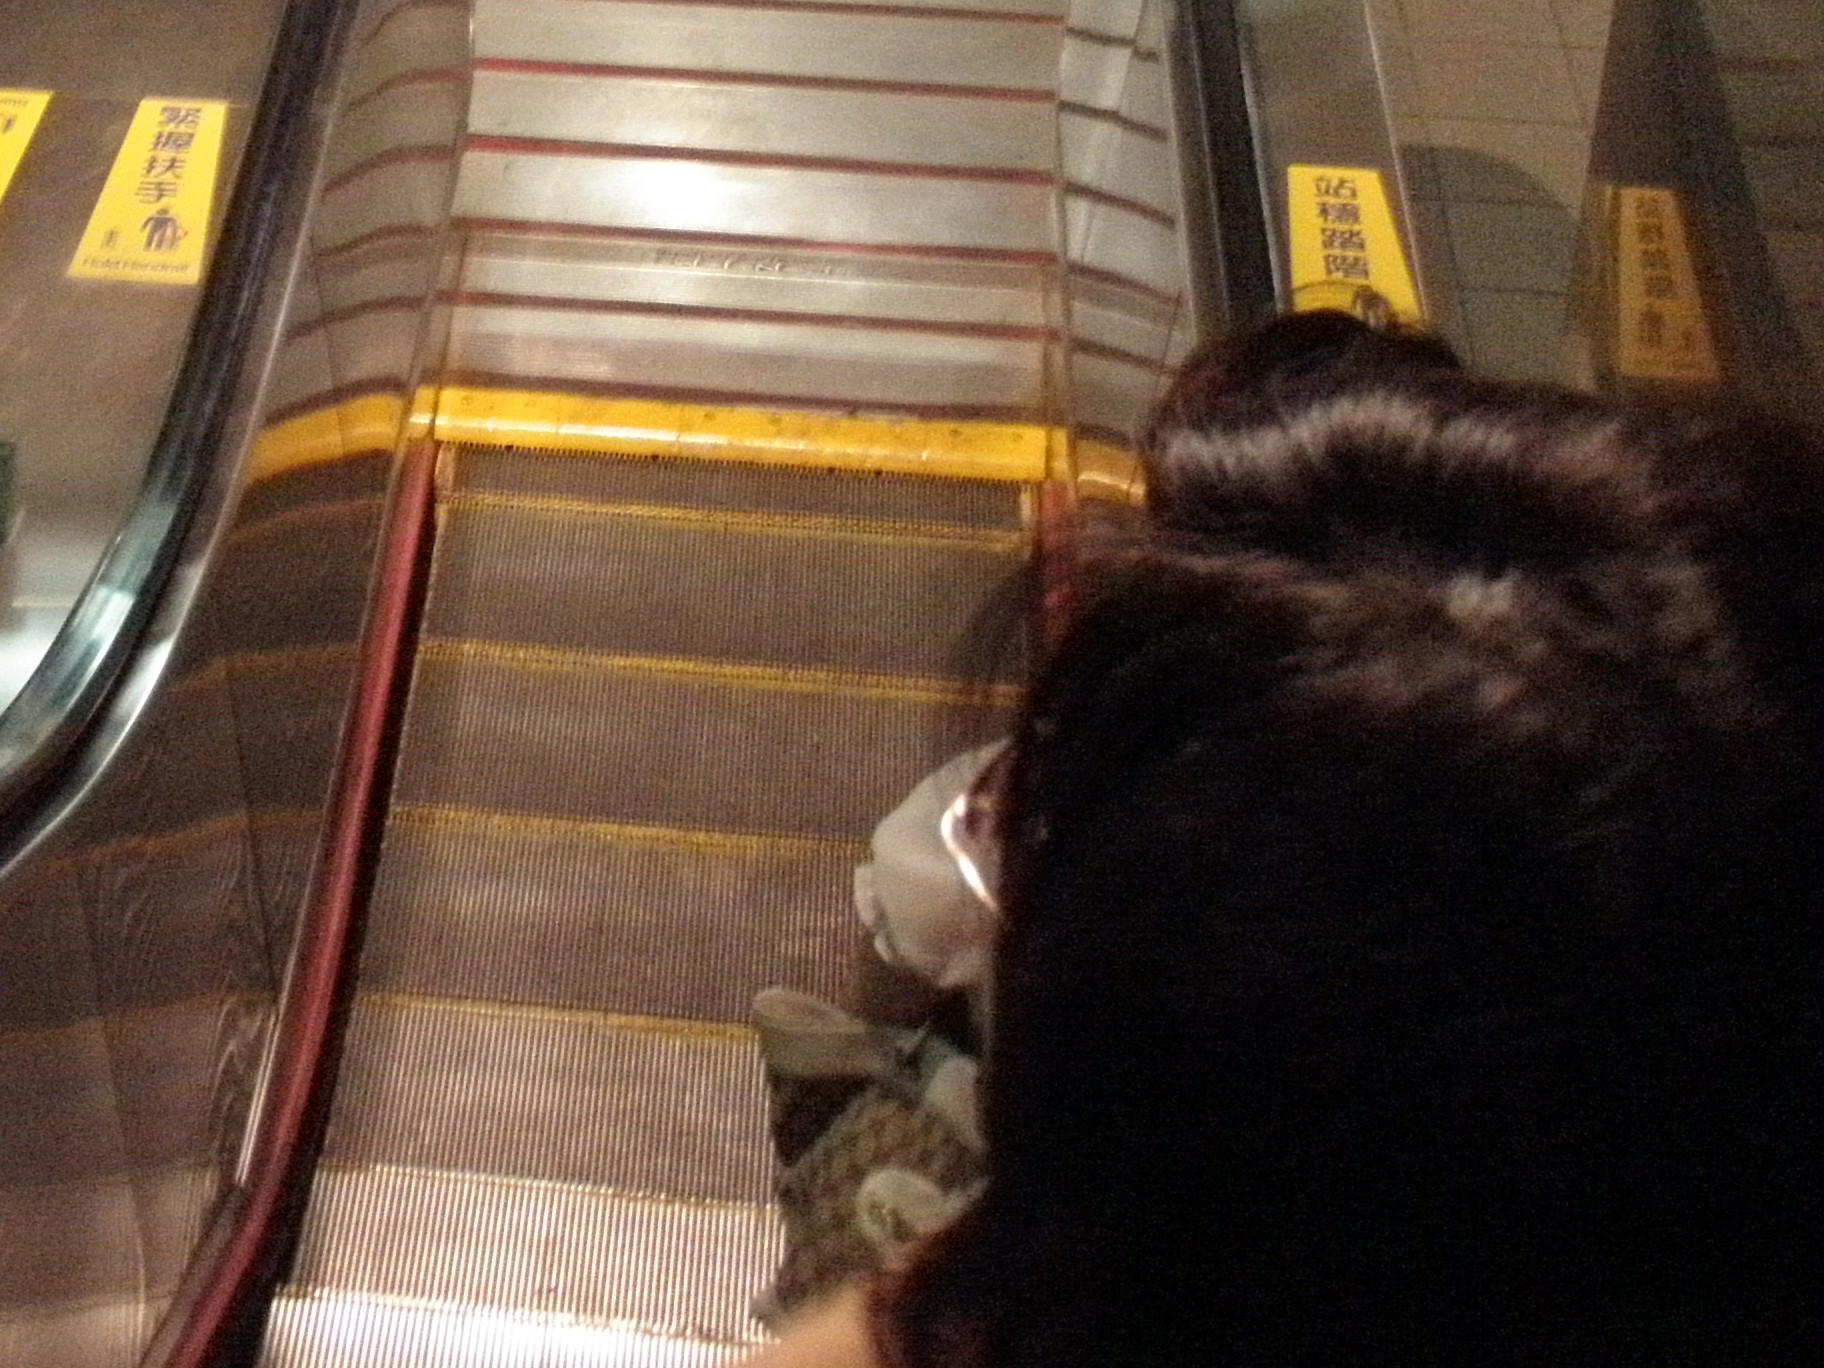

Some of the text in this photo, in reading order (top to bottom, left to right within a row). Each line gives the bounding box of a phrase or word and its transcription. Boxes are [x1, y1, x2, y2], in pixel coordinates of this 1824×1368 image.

[134, 106, 200, 204] 緊握扶手
[1314, 175, 1368, 280] 站穩踏階
